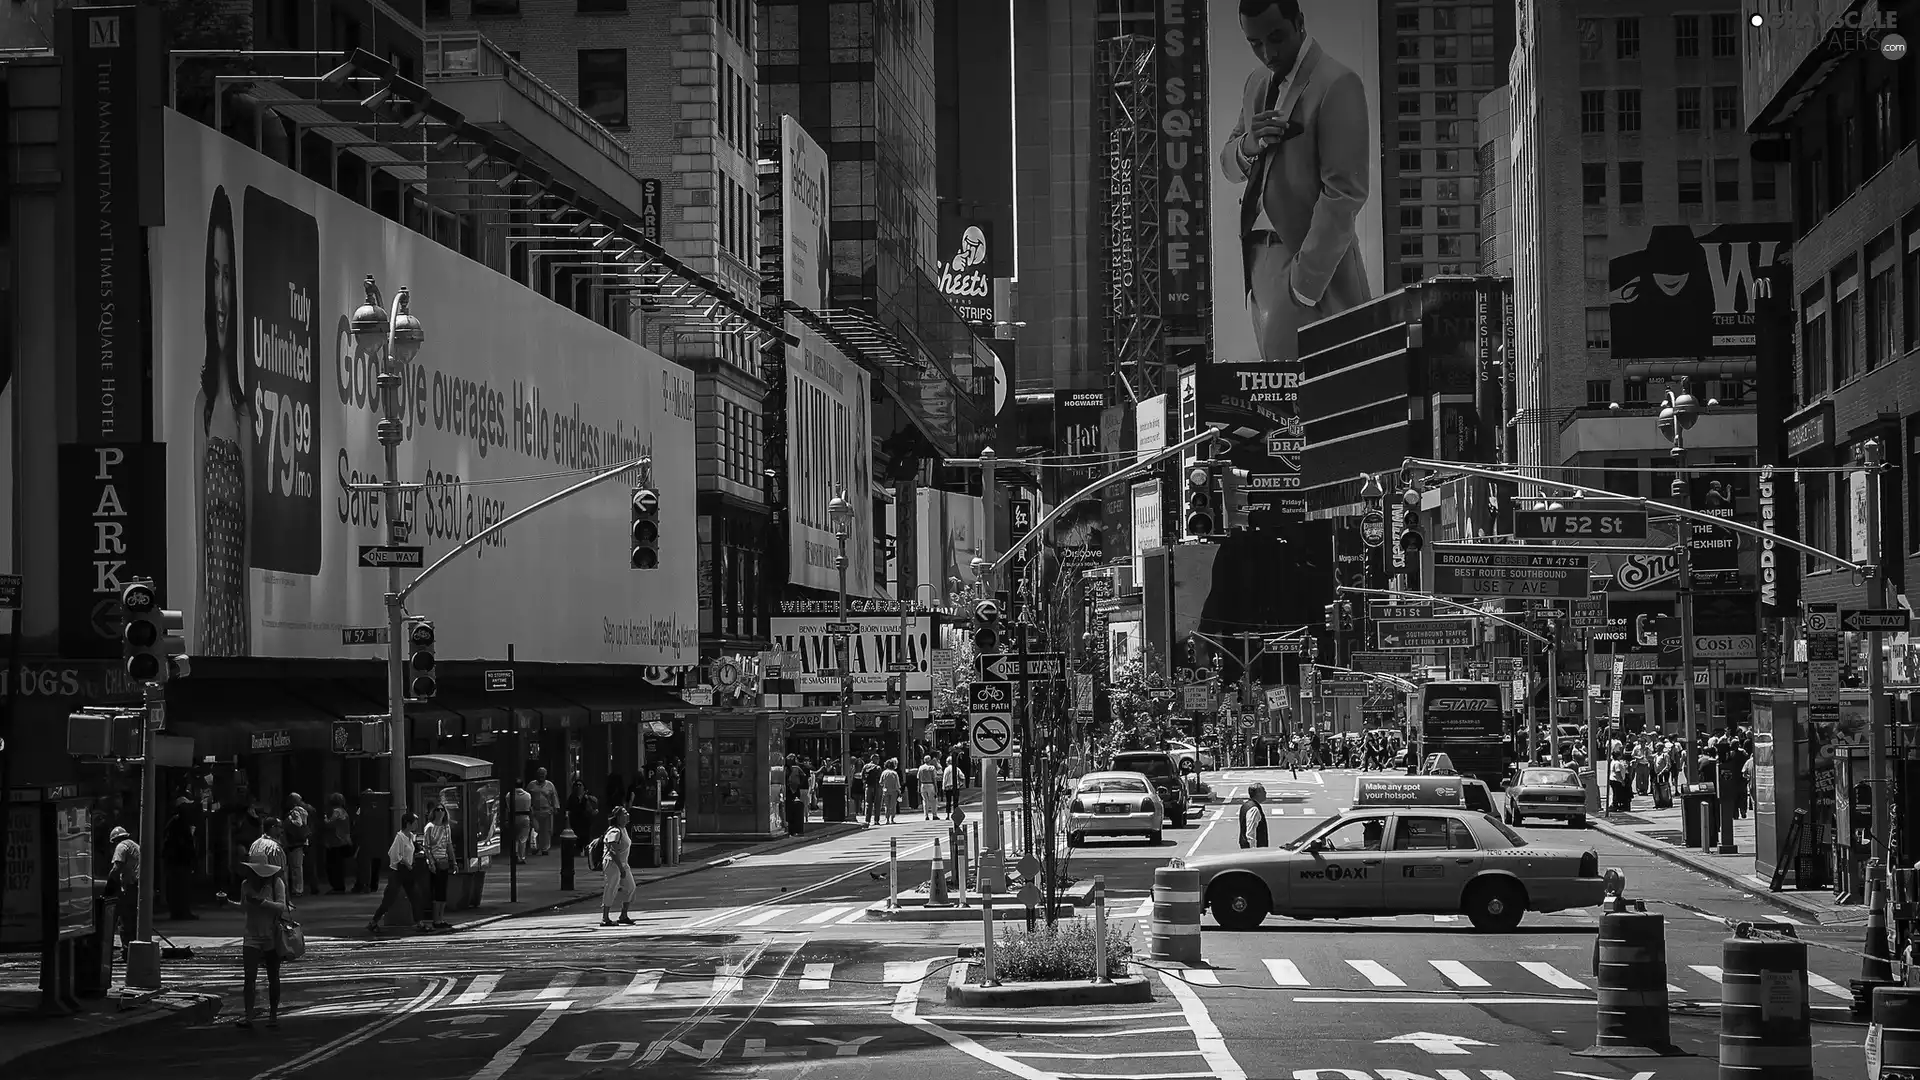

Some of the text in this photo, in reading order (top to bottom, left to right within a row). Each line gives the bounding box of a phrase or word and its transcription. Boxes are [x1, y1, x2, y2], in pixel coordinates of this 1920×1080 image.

[91, 19, 117, 46] M
[1161, 77, 1193, 270] SQUARE
[644, 181, 657, 244] STARB
[1110, 131, 1123, 317] AMERICAN EAGLE
[1121, 158, 1133, 288] OUTFITTERS
[97, 59, 115, 438] THE MANHATTAN AT TIMES SQUARE HOTEL
[1168, 292, 1190, 302] NYC
[289, 282, 312, 331] Truly
[1712, 316, 1735, 325] THE
[253, 316, 312, 383] Unlimited
[1250, 392, 1298, 402] APRIL 28
[1220, 394, 1253, 411] 2011
[1256, 404, 1279, 423] NFL
[433, 370, 508, 460] overages.
[512, 378, 549, 460] Hello
[553, 402, 600, 477] endless
[338, 447, 507, 560] Save $350 a year.
[92, 447, 127, 592] PARK
[1540, 516, 1623, 533] W 52 St
[1692, 525, 1713, 534] THE
[1759, 463, 1776, 606] McDonald's
[1693, 540, 1733, 549] EXHIBIT
[368, 552, 416, 561] ONE WAY
[1442, 555, 1580, 566] BROADWAY CLOSED AT W 47 ST
[1454, 568, 1567, 579] BEST ROUTE SOUTHBOUND
[1473, 580, 1547, 594] USE 7 AVE
[1383, 608, 1421, 617] W 51 St
[1851, 616, 1901, 625] ONE WAY
[344, 629, 375, 643] W 52 ST
[1405, 629, 1467, 638] SOUTHBOUND TRAFFIC
[1593, 632, 1628, 641] AVINGS!
[1404, 638, 1419, 646] LEFT
[1695, 636, 1734, 651] Così
[997, 662, 1020, 674] ONE
[972, 703, 1010, 711] BIKE PATH
[1438, 699, 1488, 711] STARR
[1365, 783, 1421, 792] Make any spot
[1365, 791, 1418, 800] your hotspot.
[633, 825, 652, 833] VOICE
[1300, 864, 1368, 881] NYC TAXI
[563, 1035, 884, 1063] ONLY
